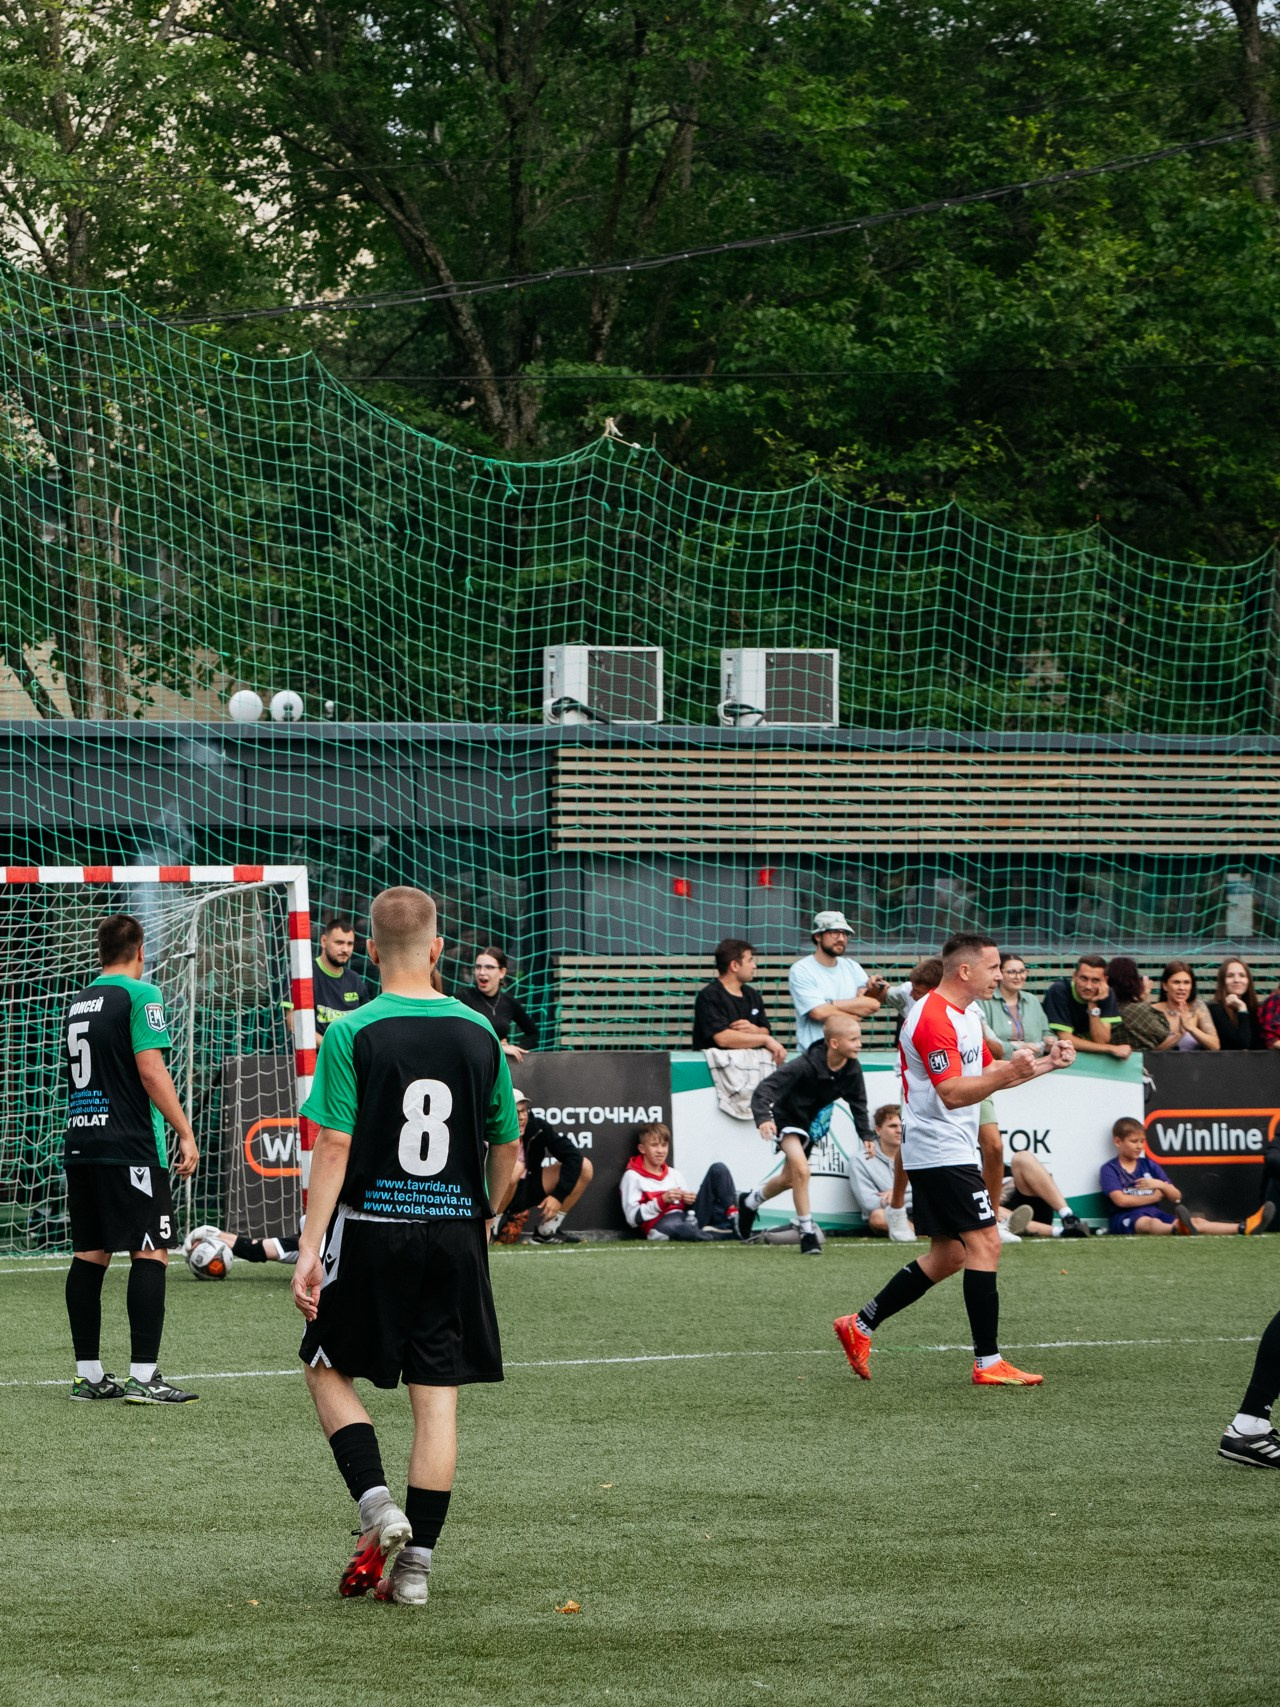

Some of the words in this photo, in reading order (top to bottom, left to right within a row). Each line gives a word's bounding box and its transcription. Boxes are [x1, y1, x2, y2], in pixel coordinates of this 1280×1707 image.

[67, 1021, 91, 1089] 5
[929, 1054, 948, 1069] EML
[72, 1114, 109, 1128] VOLAT
[529, 1106, 663, 1125] ВОСТОЧНАЯ
[398, 1079, 452, 1176] 8
[1155, 1122, 1263, 1151] Winline
[263, 1132, 301, 1162] Wi
[376, 1179, 461, 1193] www.tavrida.ru
[365, 1190, 472, 1206] www.technoavia.ru
[363, 1201, 472, 1217] www.volat-auto.ru
[159, 1215, 171, 1240] 5
